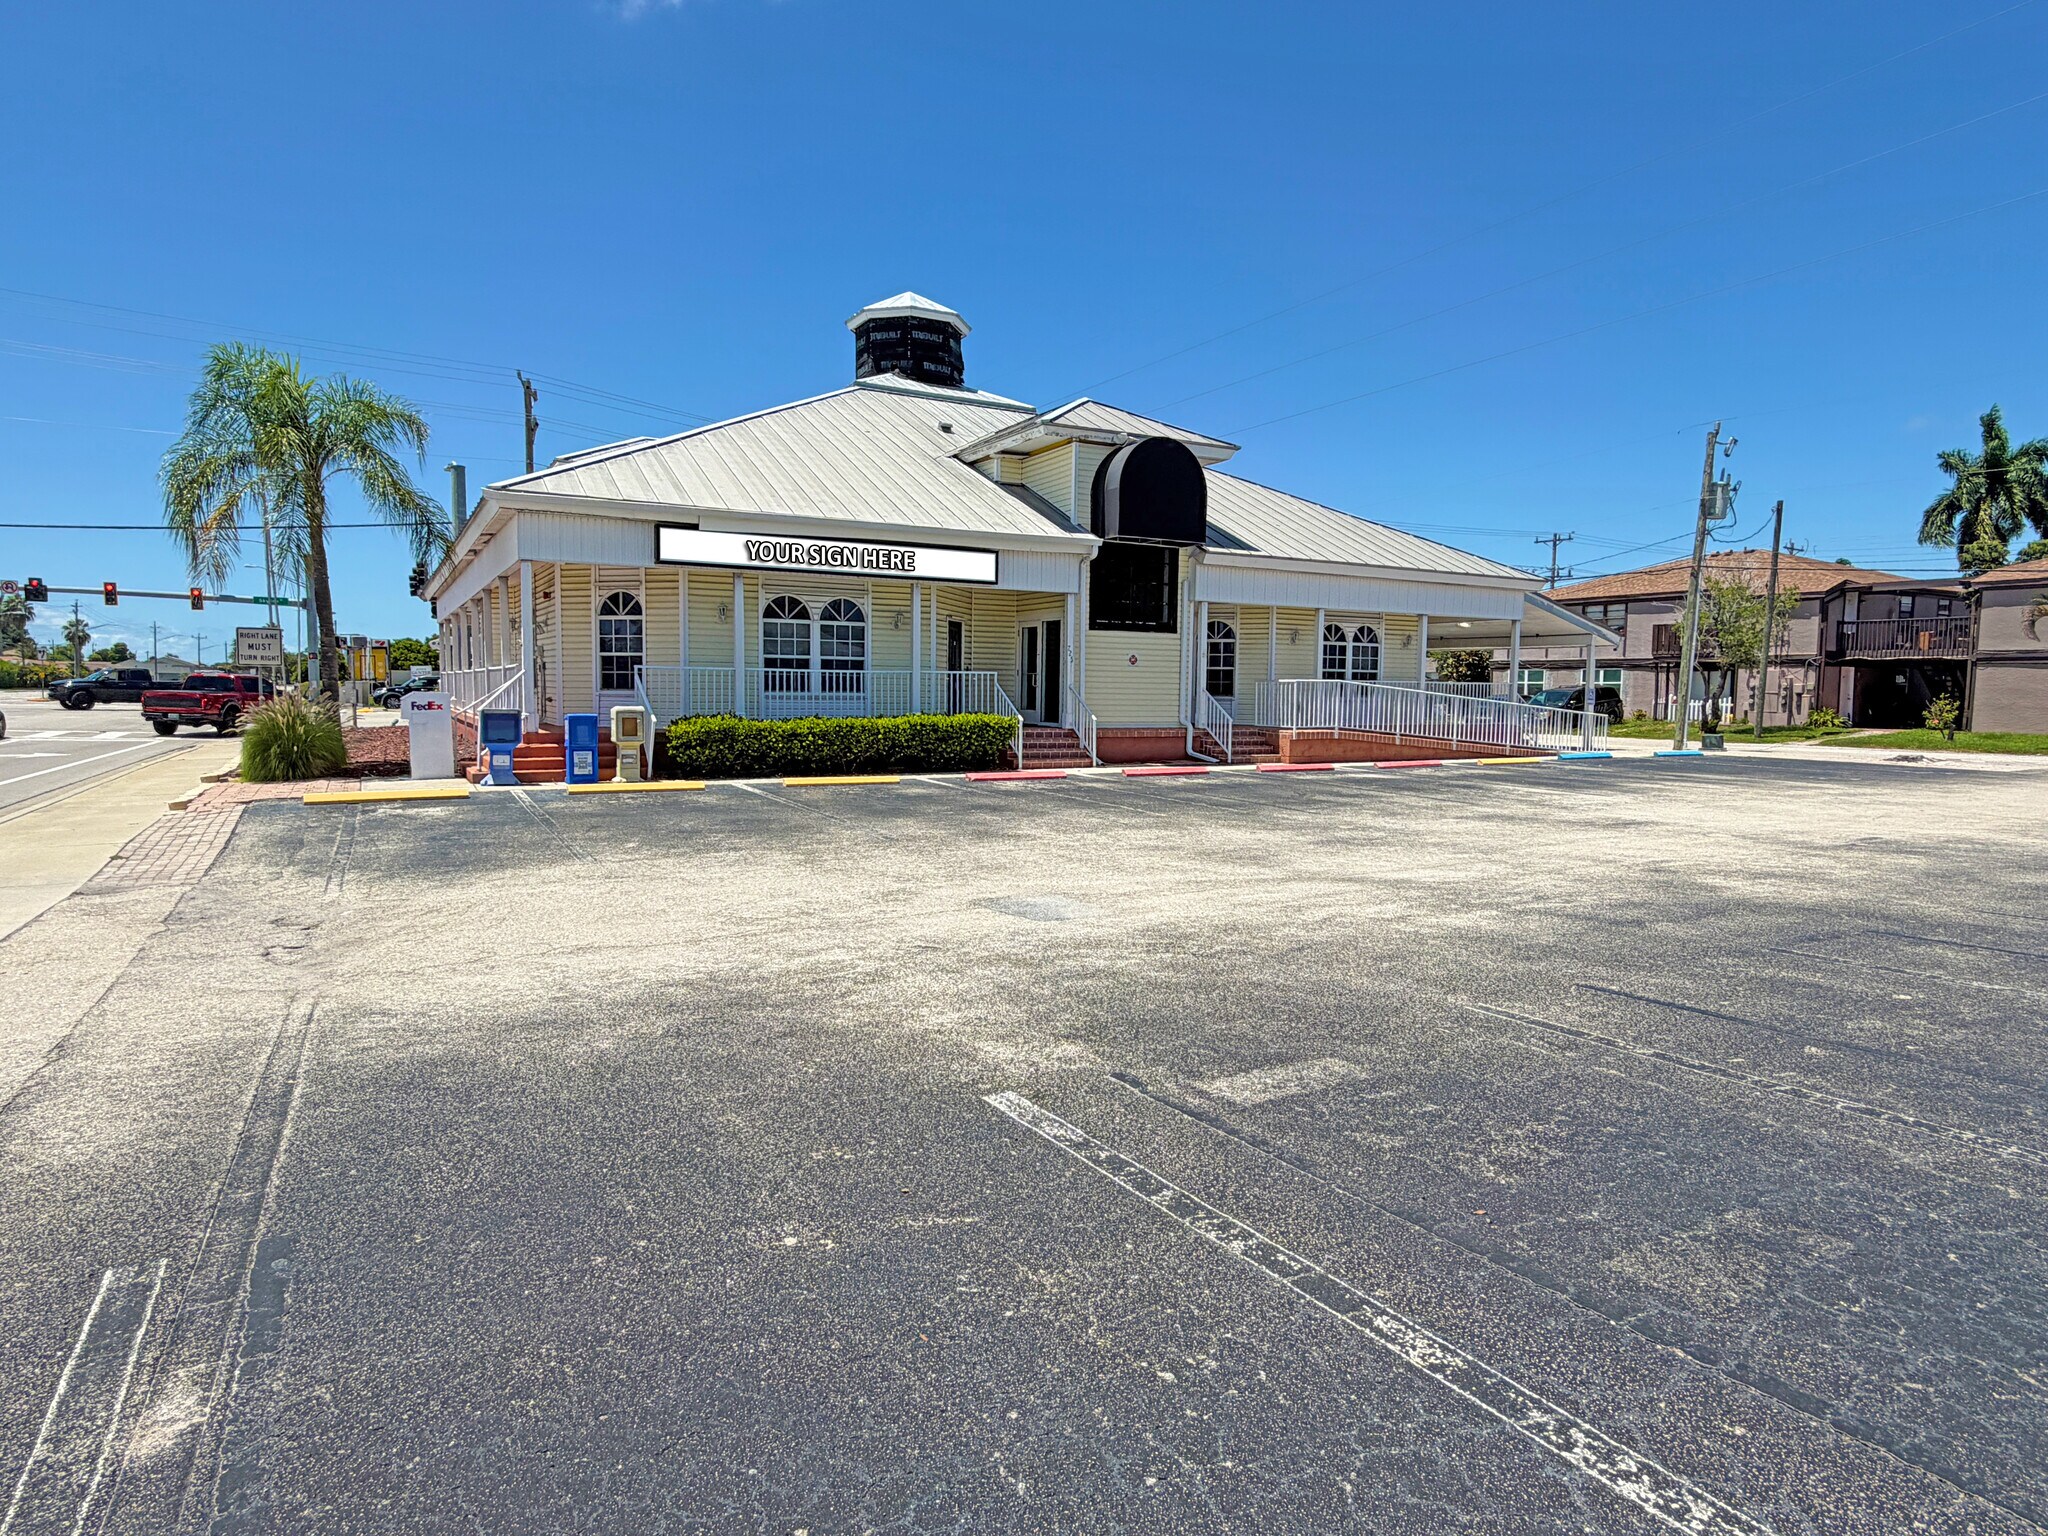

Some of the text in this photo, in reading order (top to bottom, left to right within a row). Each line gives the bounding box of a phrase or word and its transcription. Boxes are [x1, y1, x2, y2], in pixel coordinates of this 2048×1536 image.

[746, 540, 916, 571] YOUR SIGN HERE
[411, 701, 443, 710] FedEx
